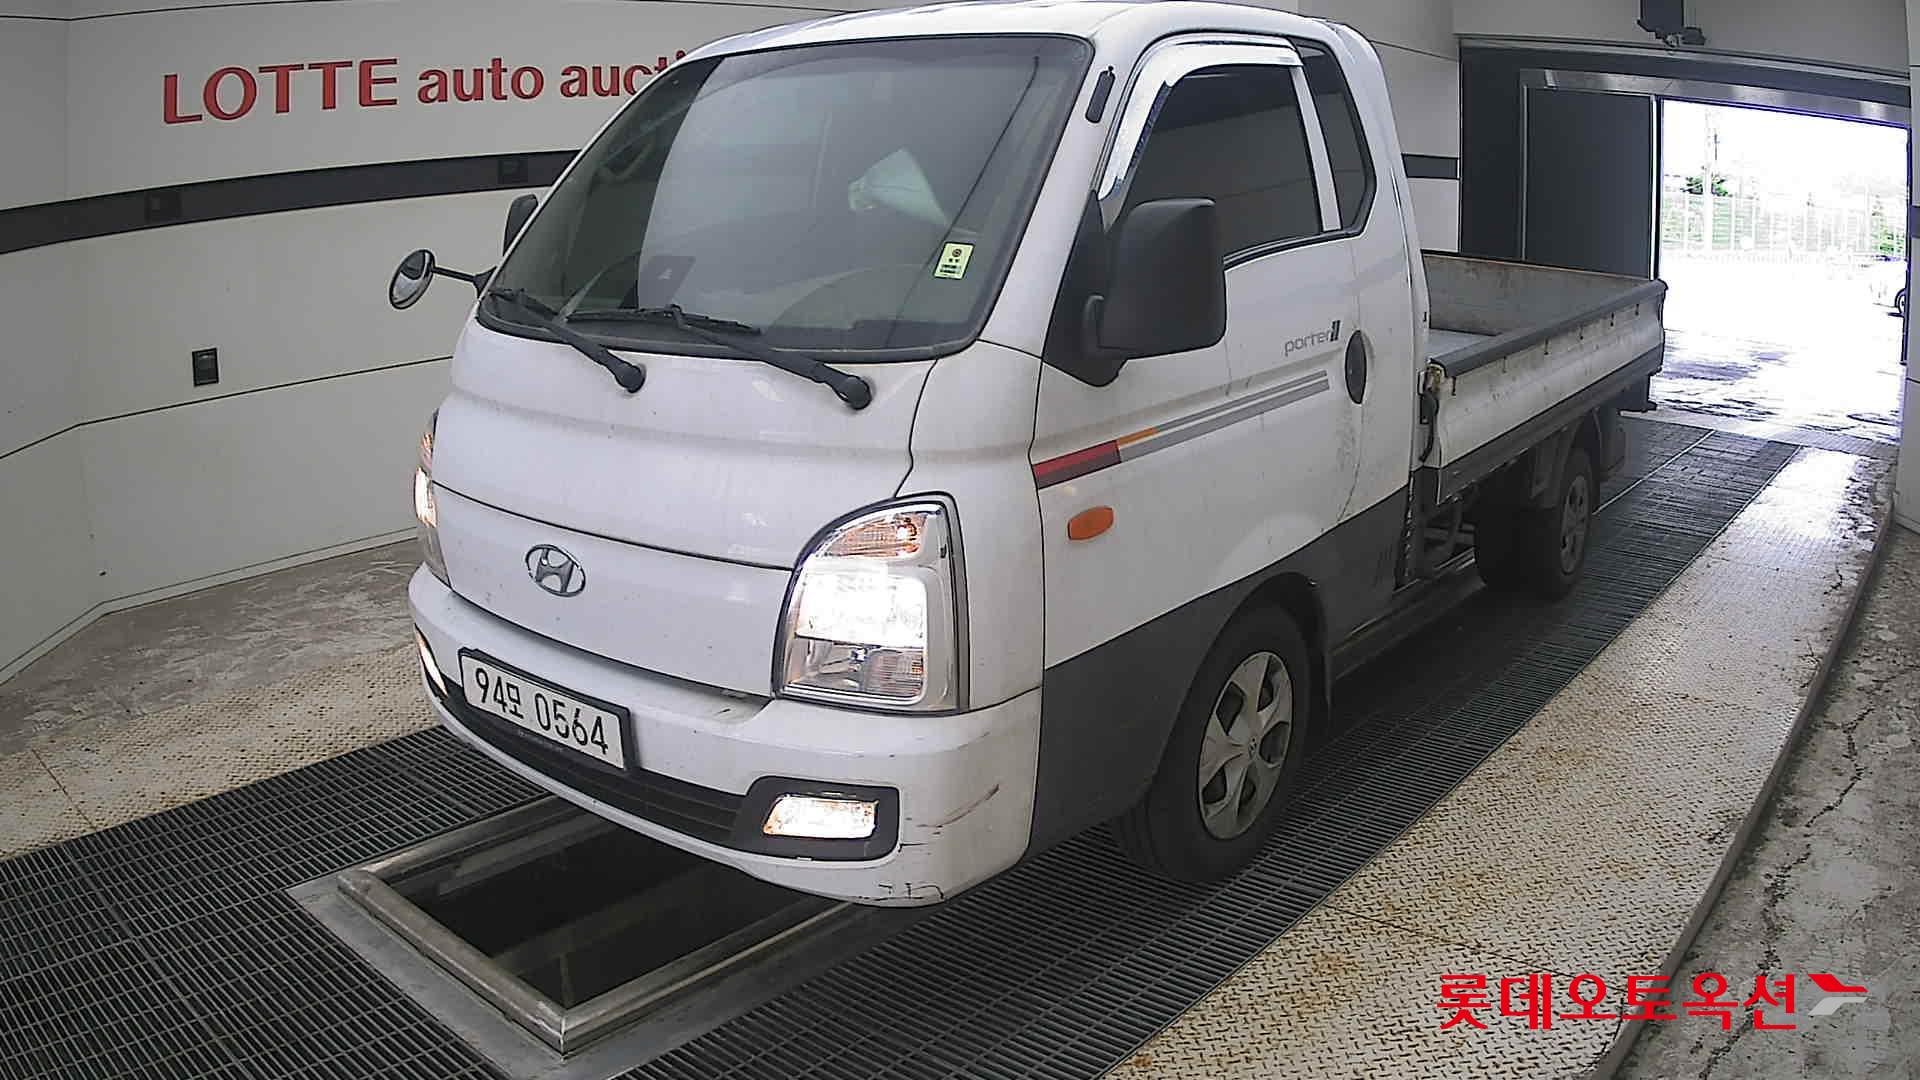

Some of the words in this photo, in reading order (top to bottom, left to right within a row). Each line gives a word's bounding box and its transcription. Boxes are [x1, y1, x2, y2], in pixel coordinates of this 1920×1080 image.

[163, 58, 398, 125] LOTTE
[417, 58, 544, 105] auto
[560, 50, 687, 98] auc
[475, 668, 524, 719] 94모
[535, 693, 608, 755] 0564
